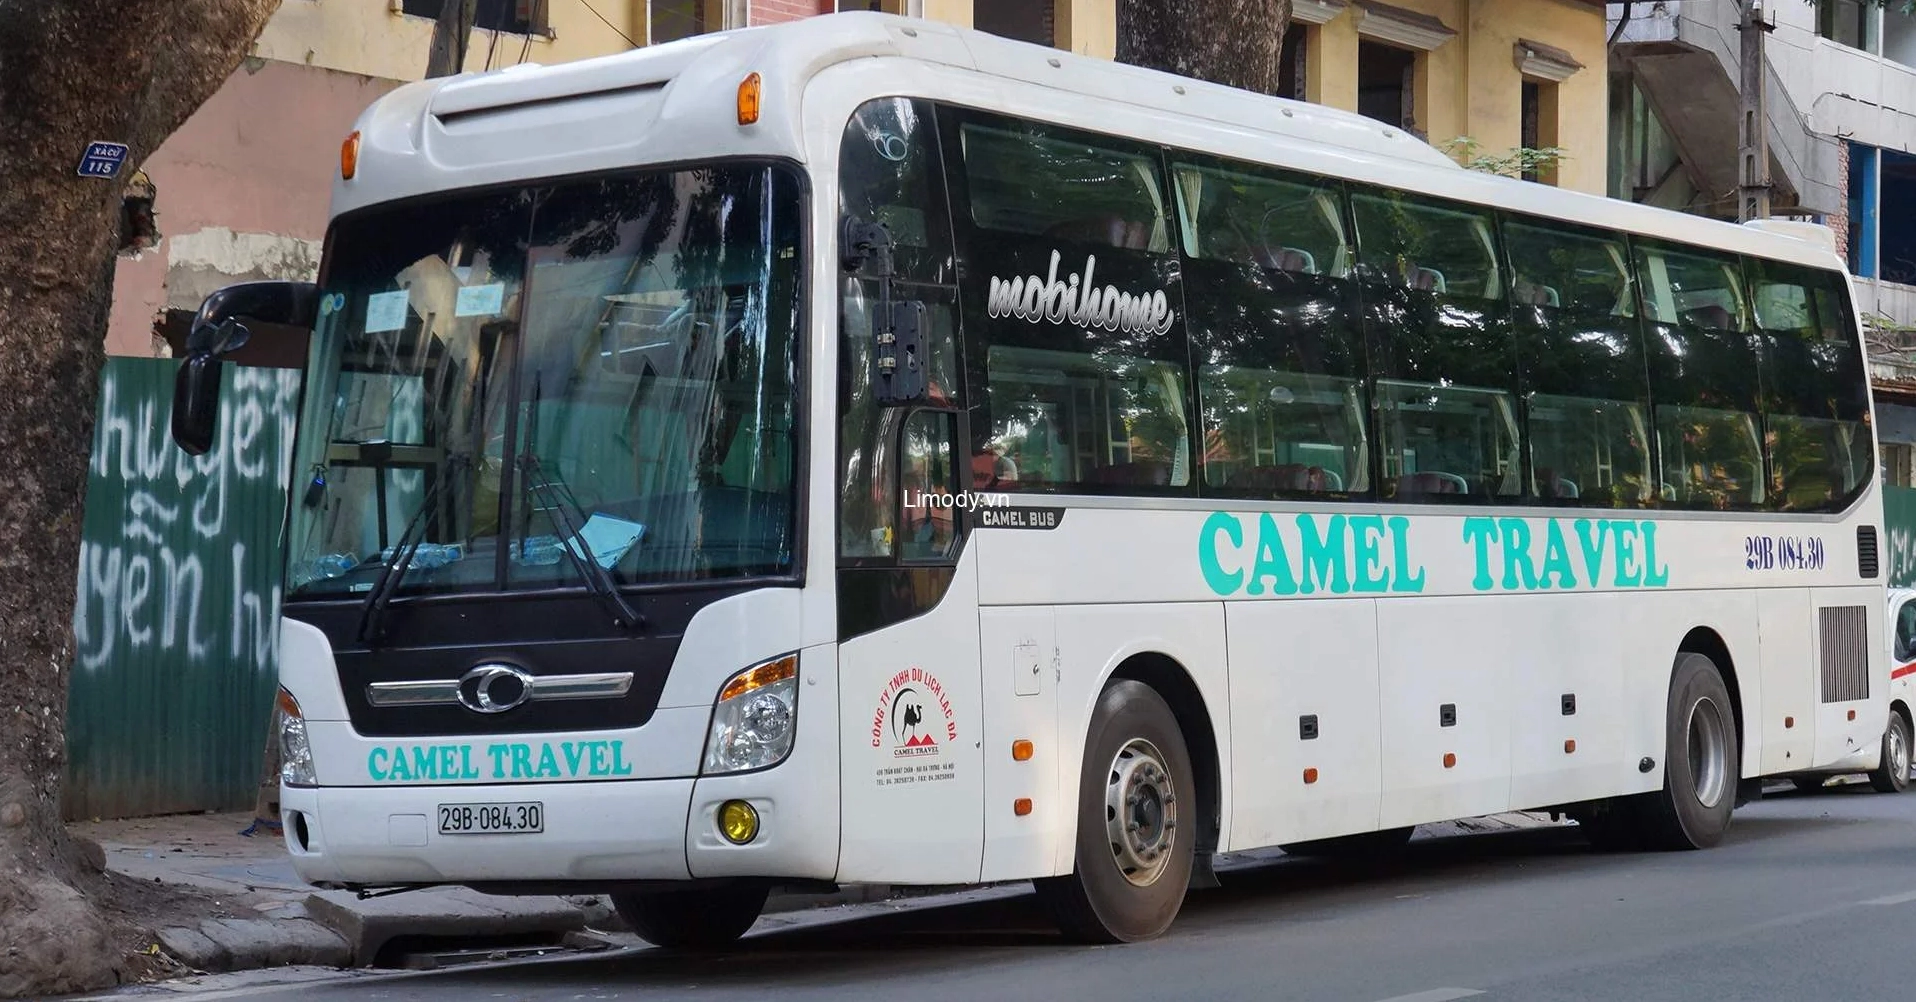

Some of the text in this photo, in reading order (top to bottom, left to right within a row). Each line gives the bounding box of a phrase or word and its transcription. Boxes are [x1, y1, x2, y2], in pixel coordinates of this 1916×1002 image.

[89, 162, 113, 173] 115
[988, 249, 1174, 335] mobihome
[983, 510, 1055, 526] CAMEL BUS
[1199, 511, 1668, 595] CAMEL TRAVEL
[1745, 536, 1824, 570] 29B 084.30
[880, 689, 890, 707] TY
[889, 669, 910, 693] TNHH
[912, 668, 922, 682] DU
[368, 740, 632, 781] CAMEL TRAVEL
[894, 746, 939, 756] CAMEL TRAVEL
[440, 804, 540, 832] 29B-084.30
